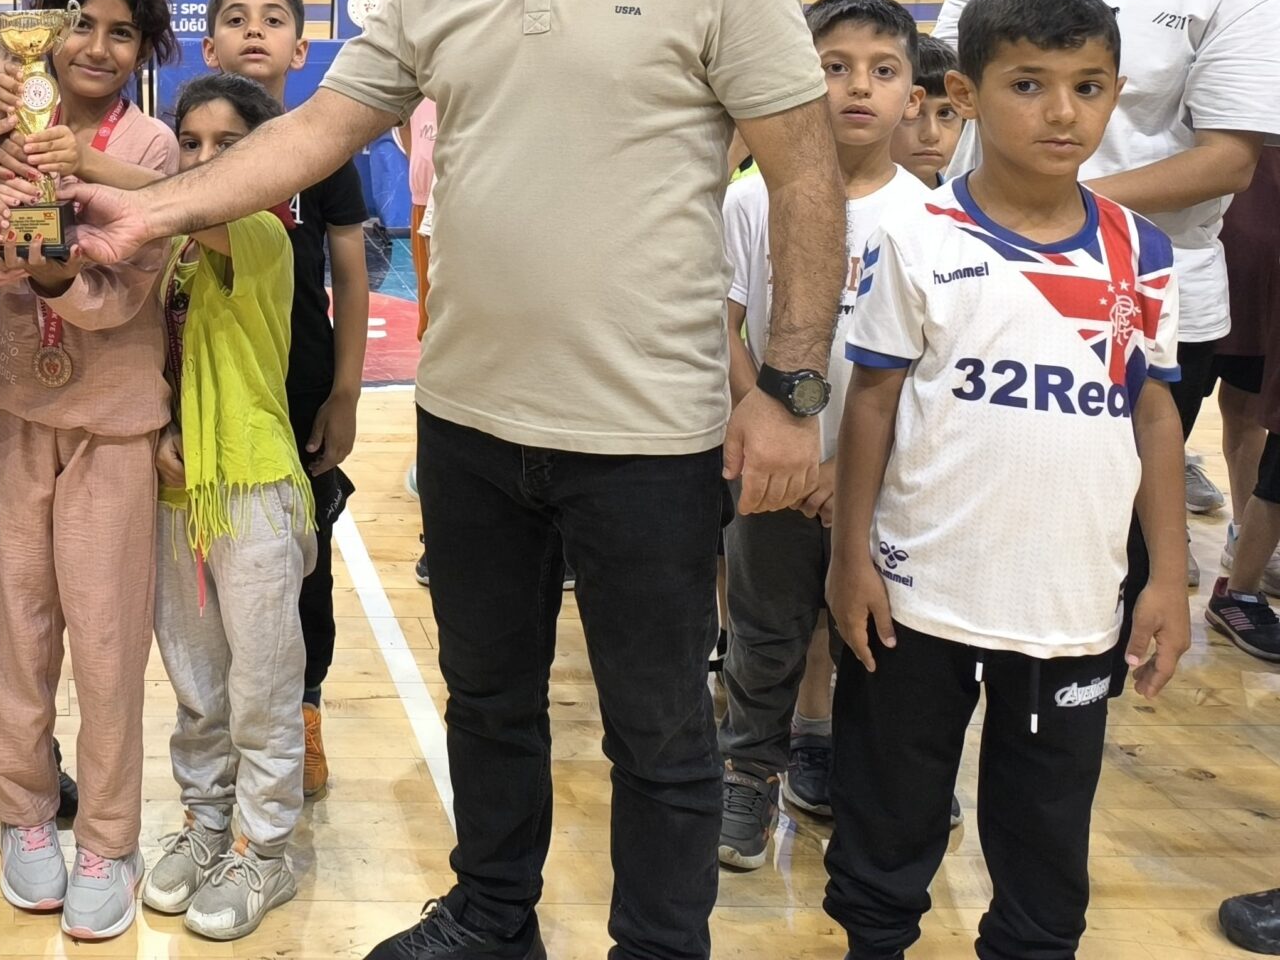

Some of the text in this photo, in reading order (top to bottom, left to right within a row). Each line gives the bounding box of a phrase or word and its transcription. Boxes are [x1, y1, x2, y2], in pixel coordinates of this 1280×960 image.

[180, 3, 208, 15] SPO
[615, 5, 642, 16] USPA
[933, 262, 990, 285] hummel
